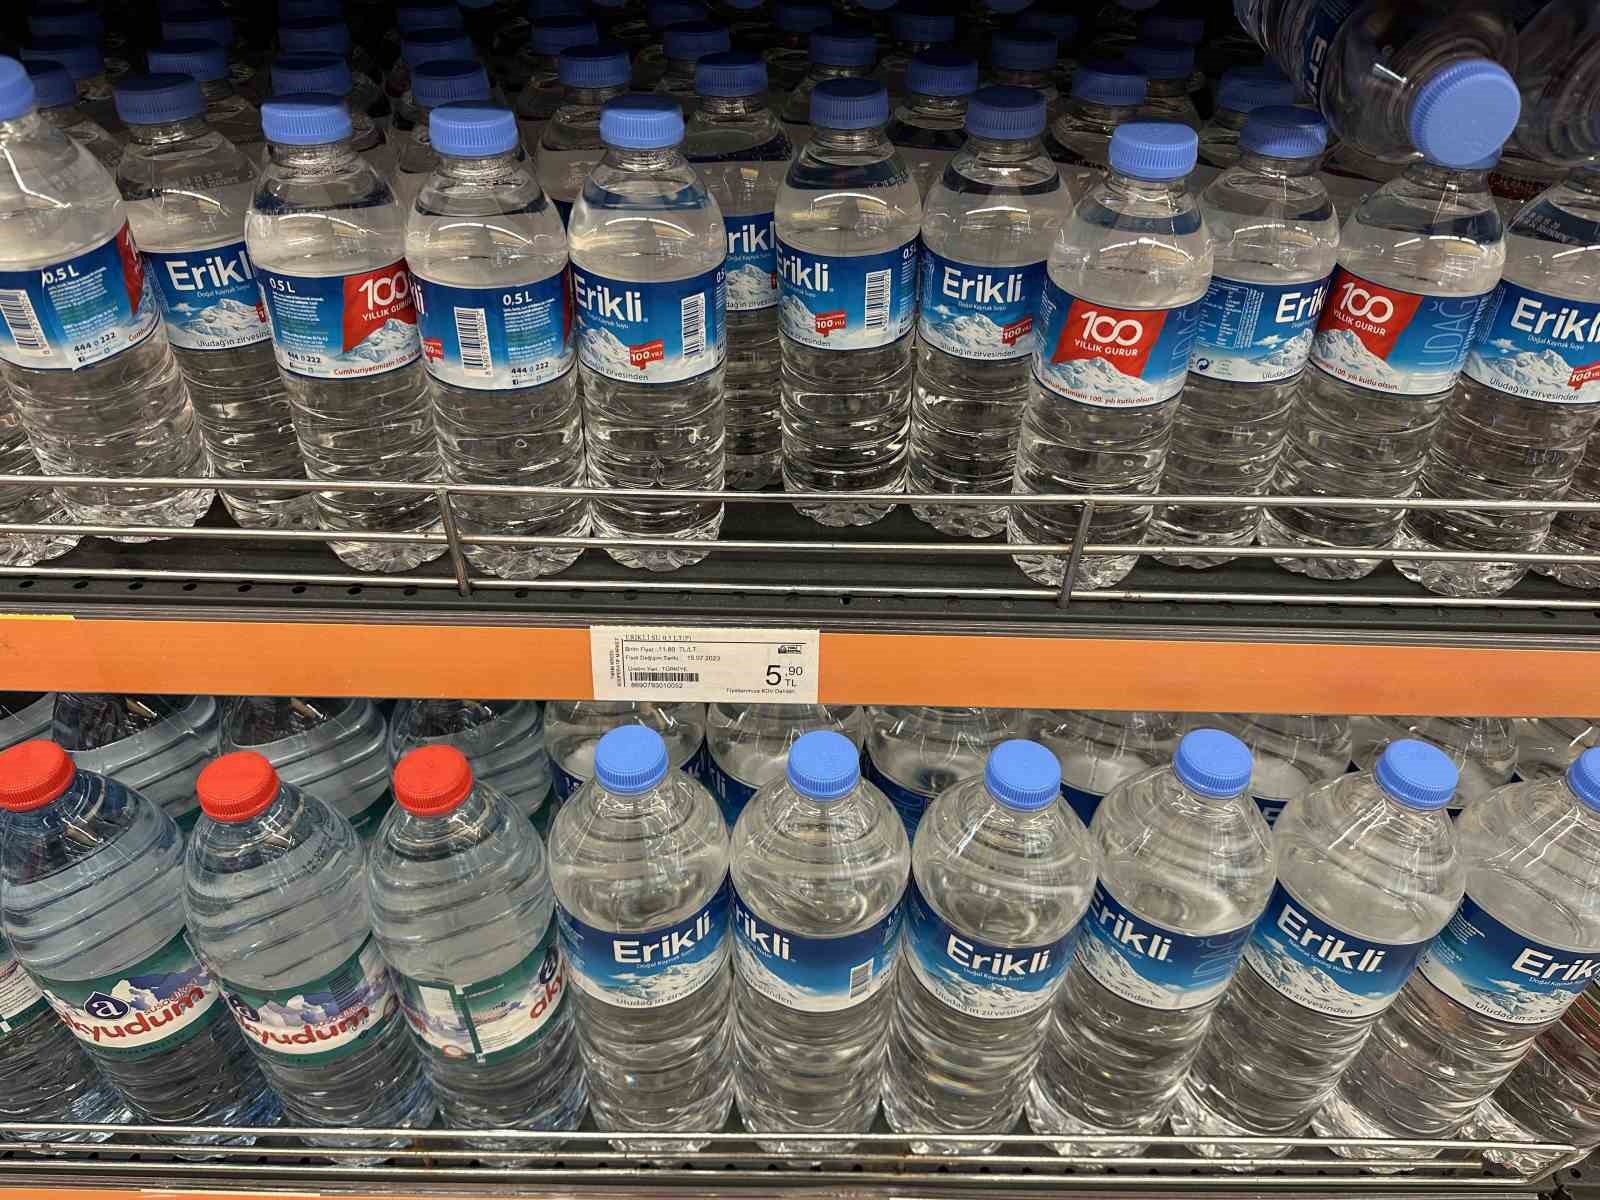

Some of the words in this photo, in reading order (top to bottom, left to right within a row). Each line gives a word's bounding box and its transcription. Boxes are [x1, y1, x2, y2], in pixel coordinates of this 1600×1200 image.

[69, 264, 80, 278] L
[776, 243, 829, 292] Erikli
[942, 266, 1023, 304] Erikli
[286, 281, 296, 294] L
[358, 270, 409, 311] 100
[525, 291, 533, 303] L
[574, 272, 642, 322] Erikli
[1340, 281, 1394, 324] 100
[1081, 311, 1143, 346] 100
[1355, 319, 1387, 337] GURUR
[1511, 297, 1600, 343] Erikl
[631, 351, 650, 362] 100
[1074, 338, 1103, 353] YILLIK
[1104, 346, 1139, 357] GURUR
[765, 664, 782, 686] 5
[785, 679, 797, 687] TL
[612, 910, 711, 963] Erikli
[735, 904, 790, 961] rikli
[1276, 903, 1386, 973] Erikli
[946, 933, 1050, 976] Erikli
[91, 1000, 122, 1017] a
